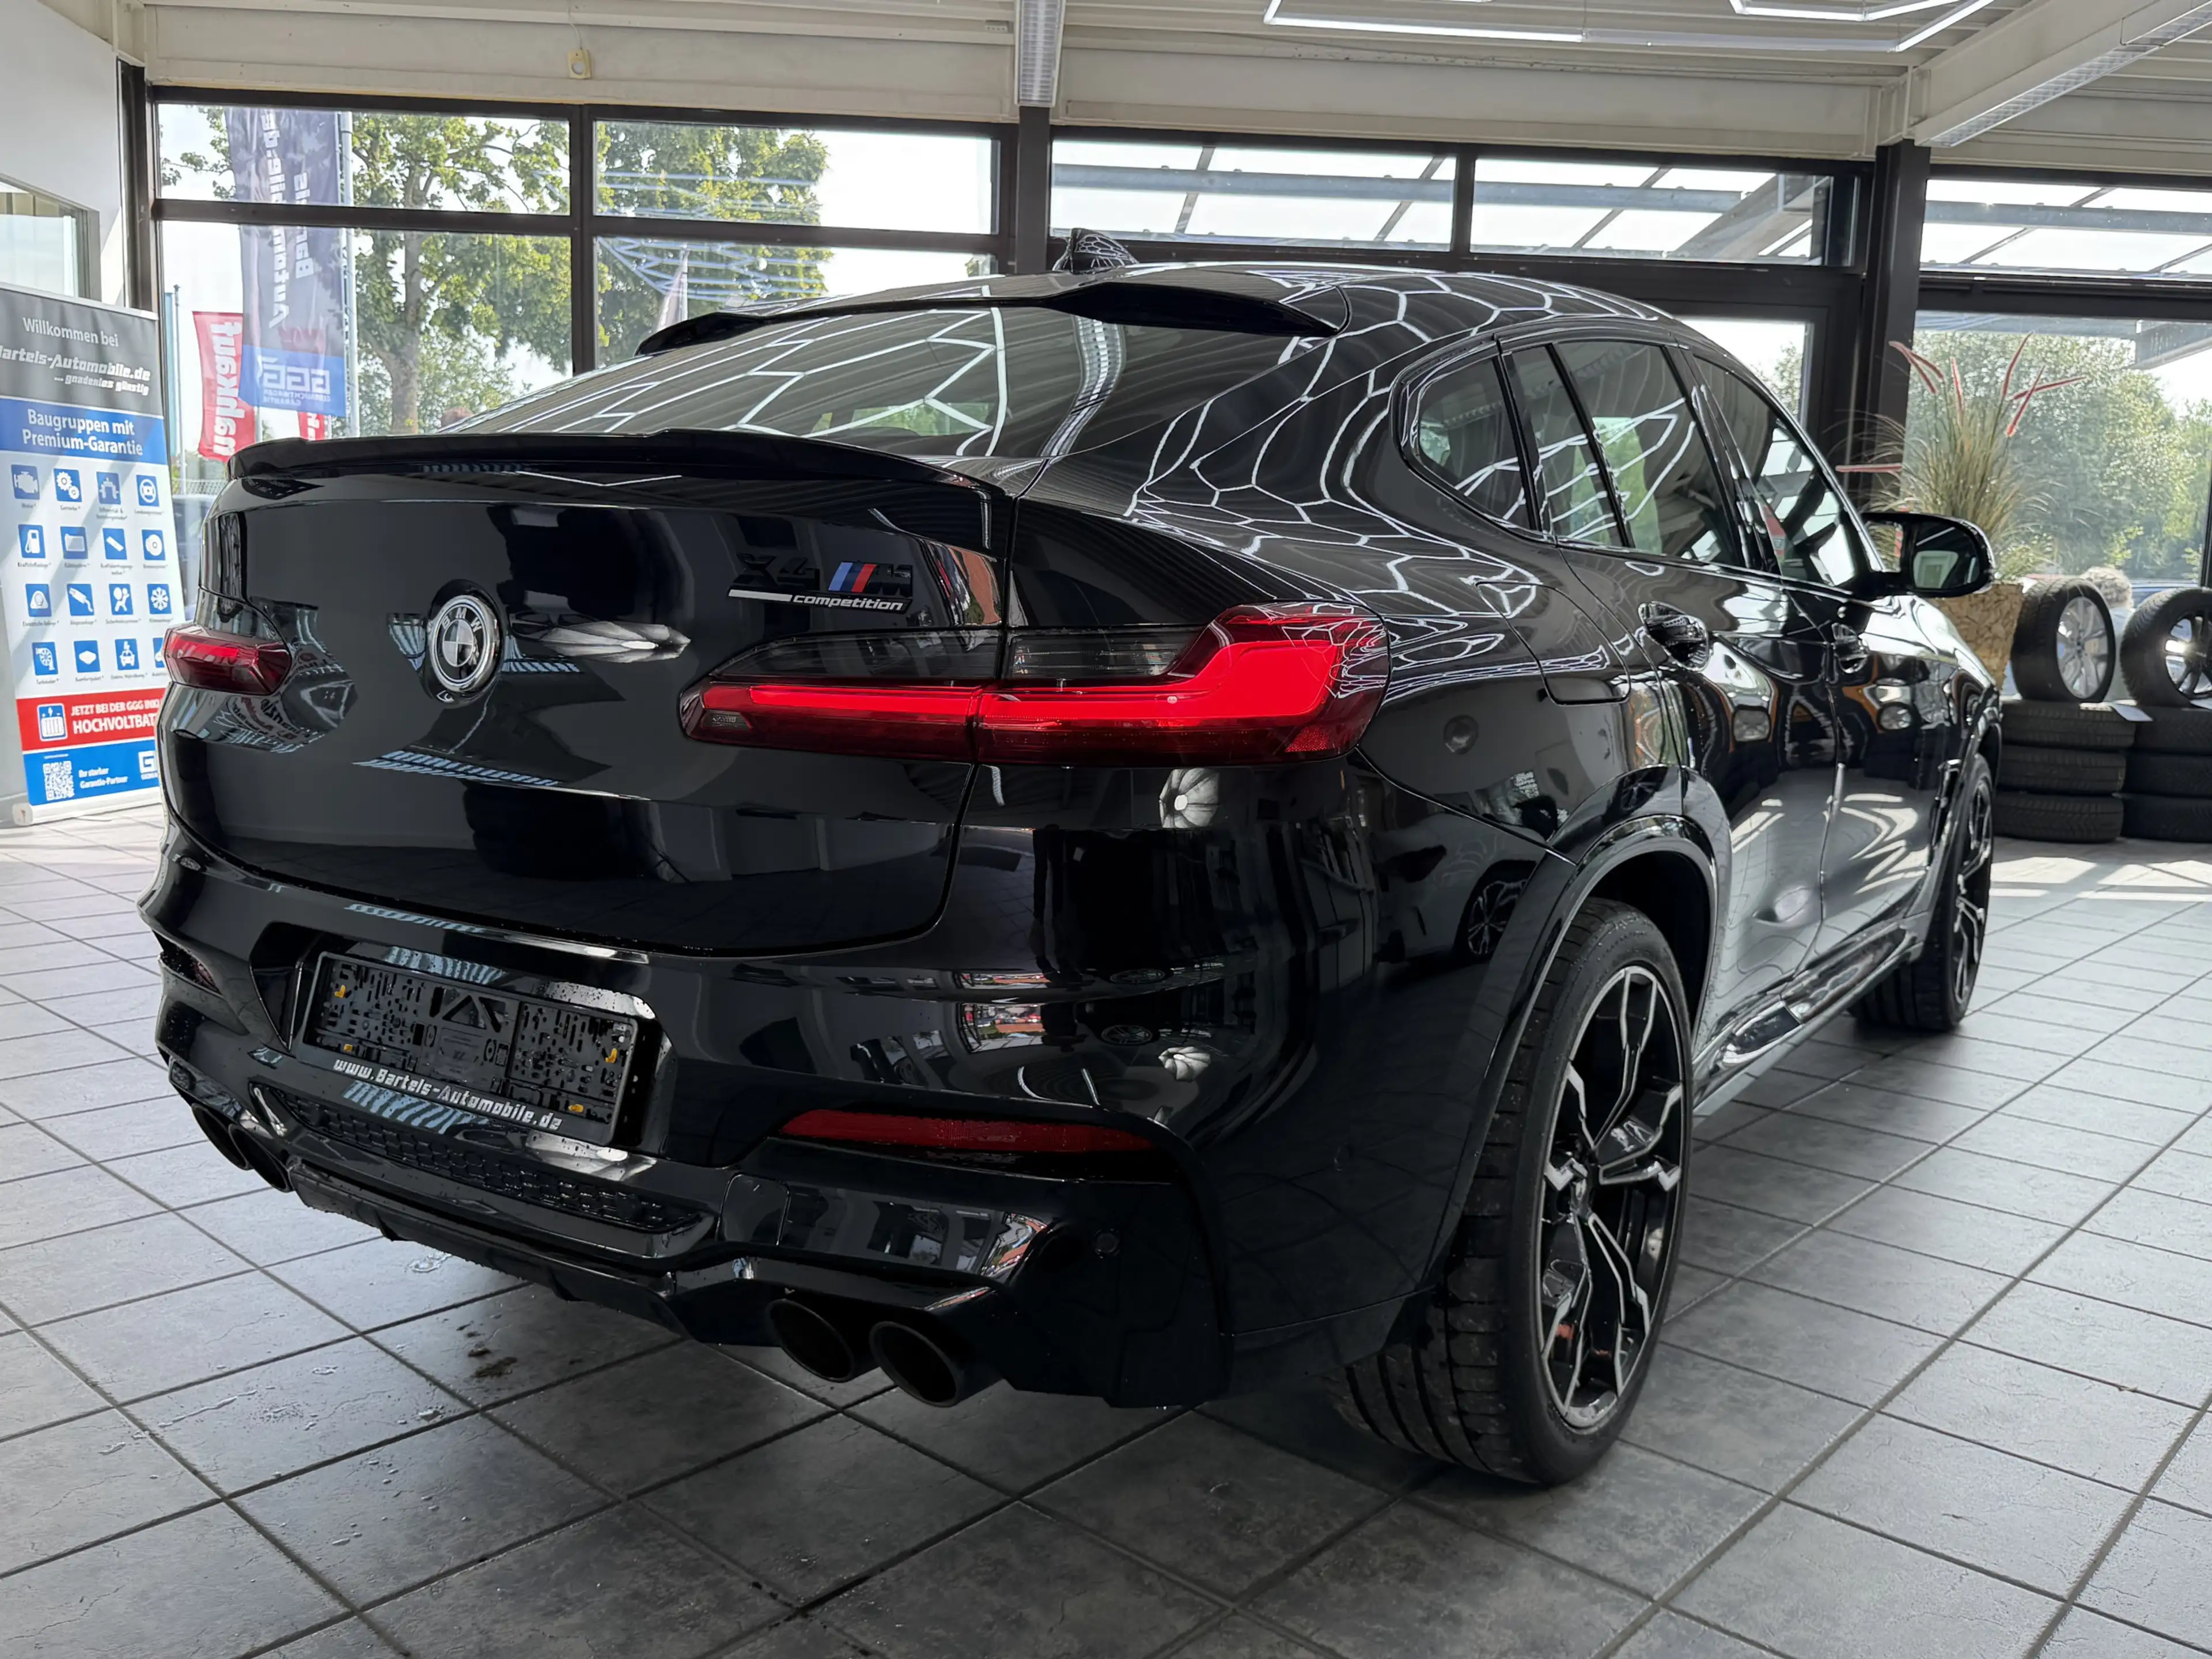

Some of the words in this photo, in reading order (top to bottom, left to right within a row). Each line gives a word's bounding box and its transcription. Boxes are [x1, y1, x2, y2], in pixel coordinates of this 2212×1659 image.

[22, 317, 99, 344] Willkommen
[101, 331, 119, 347] bei
[65, 374, 114, 388] gnadenlos
[115, 381, 150, 396] günstig
[28, 408, 109, 435] Baugruppen
[112, 420, 135, 435] mit
[22, 430, 143, 456] Premium-Garantie
[732, 552, 820, 592] X4
[852, 561, 913, 597] M
[793, 594, 904, 612] competition
[441, 607, 483, 634] BMW
[71, 704, 94, 716] JETZT
[96, 703, 108, 714] BEI
[110, 702, 126, 713] DER
[126, 700, 143, 711] GGG
[333, 1058, 562, 1131] www.Bartels-Automobile.de
